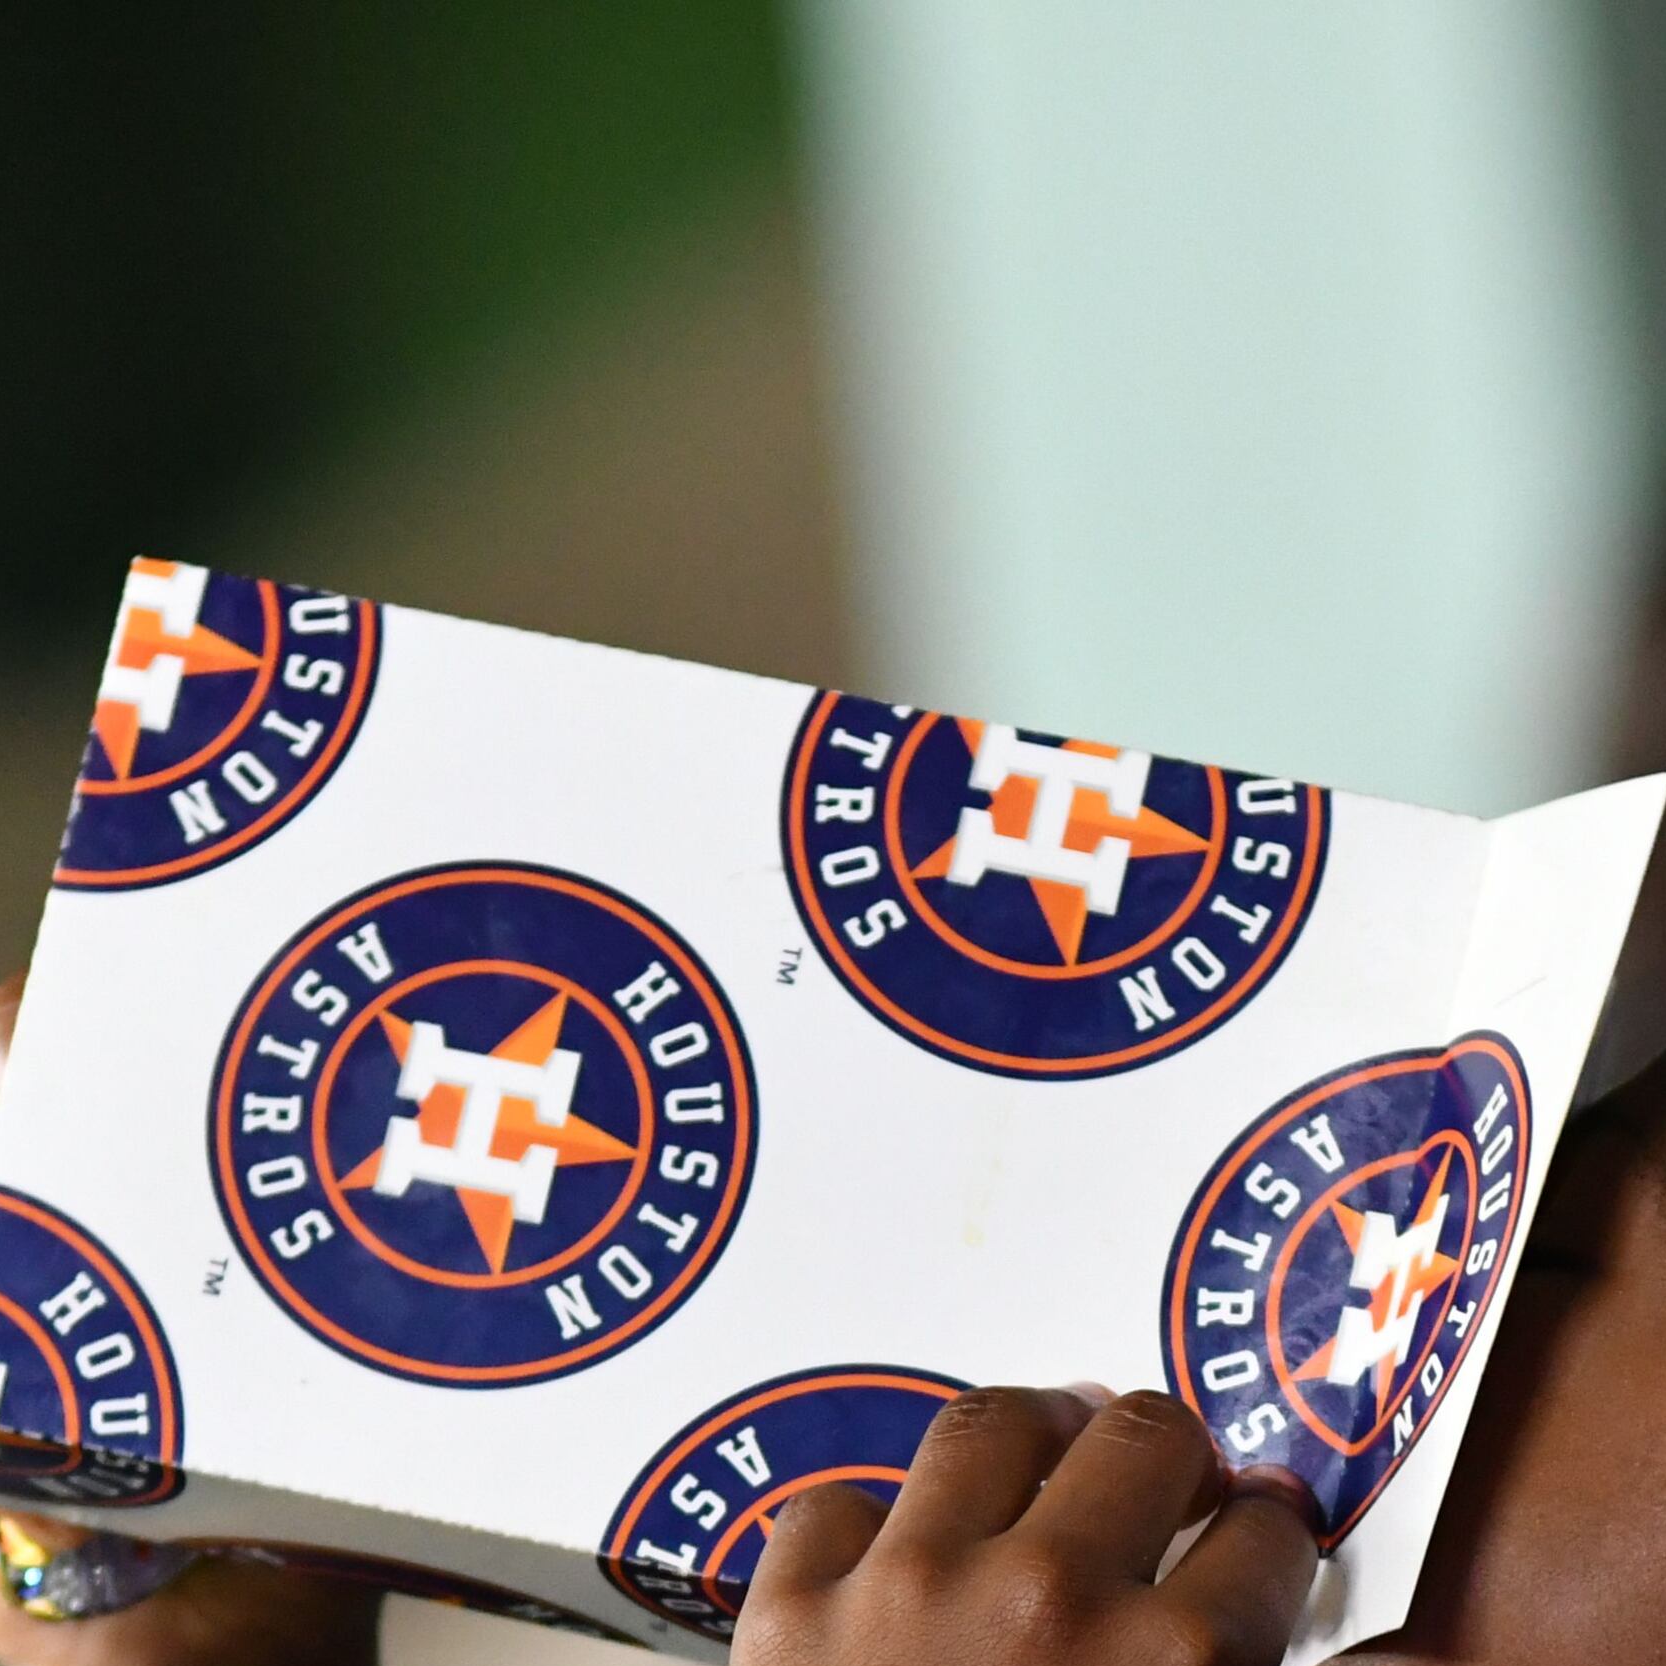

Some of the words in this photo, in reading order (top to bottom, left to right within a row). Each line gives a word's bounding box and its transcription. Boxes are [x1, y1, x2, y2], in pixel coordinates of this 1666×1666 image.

[815, 705, 913, 949] TROS
[242, 922, 393, 1259] ASTROS
[545, 961, 724, 1340] HOUSTON
[1197, 1113, 1345, 1453] ASTROS
[1392, 1083, 1511, 1458] HOUSTON
